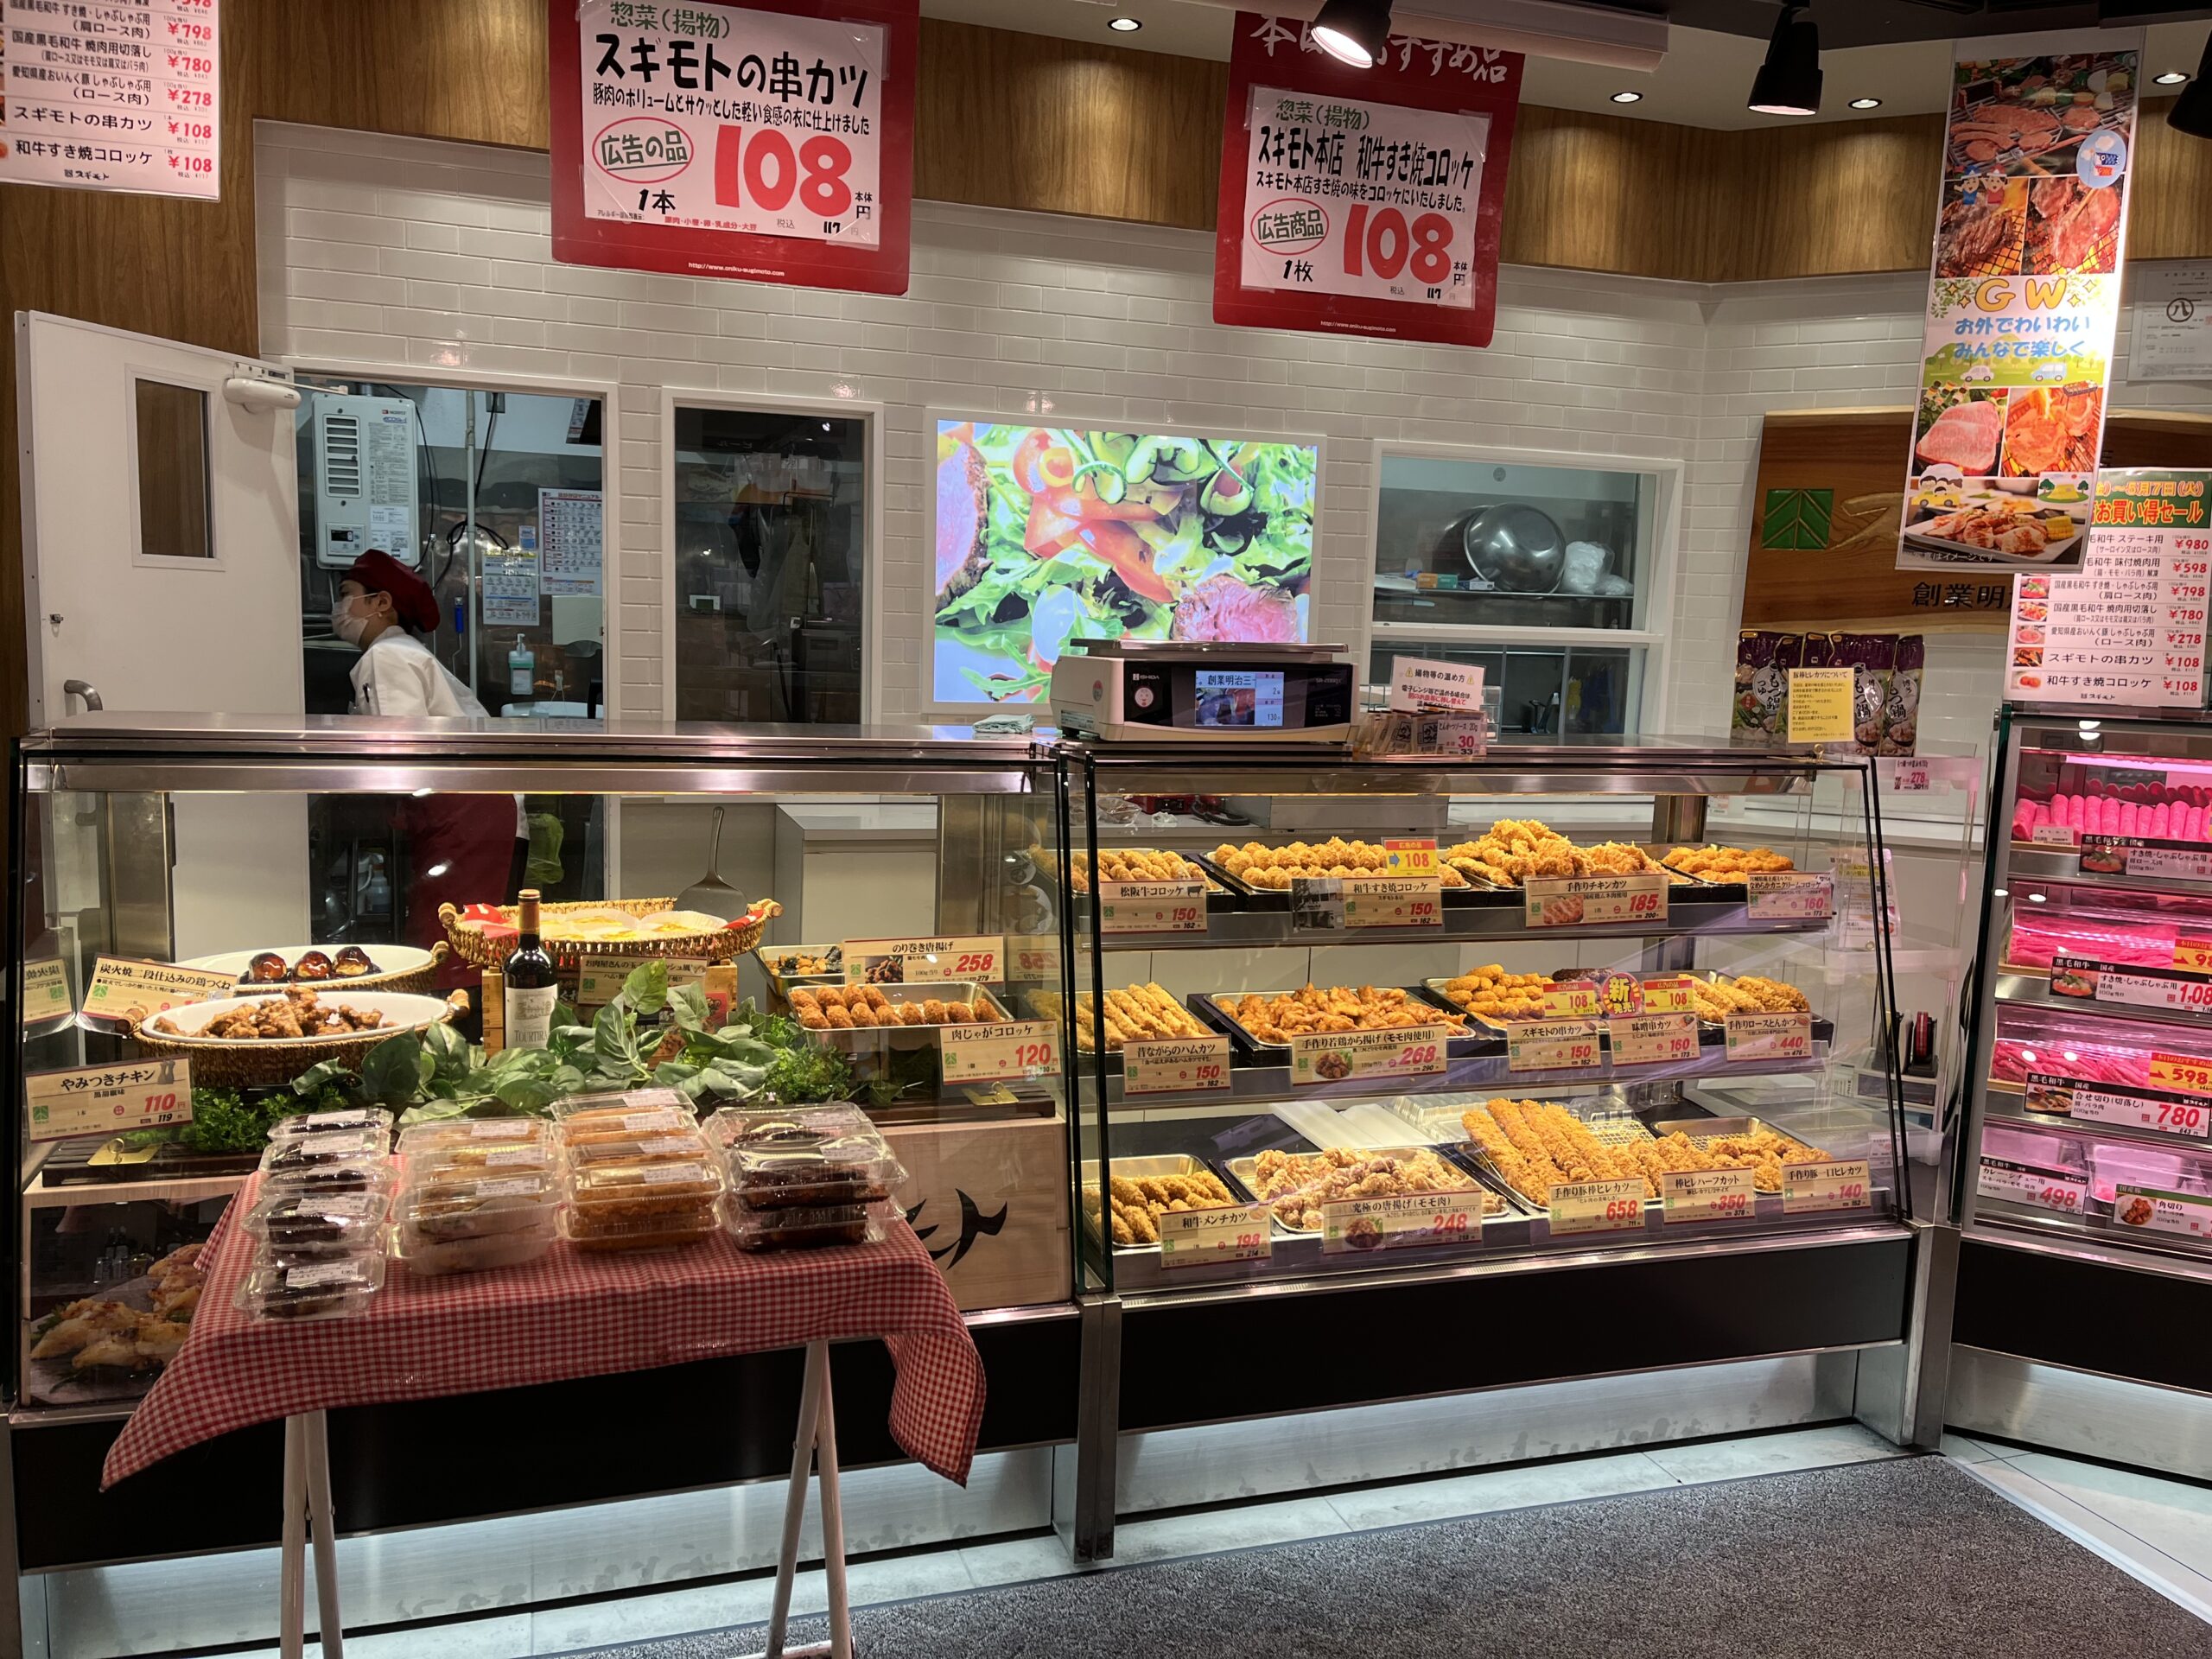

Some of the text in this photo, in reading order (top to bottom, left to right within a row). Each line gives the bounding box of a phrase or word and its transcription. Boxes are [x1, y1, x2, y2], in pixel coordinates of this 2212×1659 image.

[12, 30, 152, 58] 国産黒毛和牛 焼肉用切落し
[595, 33, 868, 108] スギモトの串カツ
[92, 74, 151, 92] しゃぶしゃぶ用
[593, 82, 869, 135] 豚肉のボリュームとサクッとした軽い食感の衣に仕上げました
[14, 105, 152, 131] スギモトの串カツ
[16, 139, 153, 165] 和牛すき焼コロッケ
[601, 130, 688, 165] 広告の品
[1357, 133, 1474, 190] 和牛すき焼コロッケ
[715, 124, 851, 217] 108
[639, 189, 676, 214] 1本
[855, 191, 873, 203] 本体
[856, 206, 871, 220] 円
[777, 219, 795, 230] 税込
[823, 221, 841, 234] 117
[1257, 209, 1324, 240] 広告商品
[1344, 204, 1453, 284] 108
[1283, 260, 1313, 283] 1枚
[1390, 285, 1404, 296] 税込
[1427, 287, 1441, 299] 117
[1954, 316, 2090, 335] お外でわいわい
[1953, 340, 2085, 359] みんなで楽しく
[2091, 499, 2204, 524] お買い得セール
[2118, 535, 2164, 543] ステーキ用
[1912, 582, 2012, 609] 創業明
[2049, 653, 2153, 664] スギモトの串カツ
[2047, 675, 2152, 688] 和牛すき焼コロッケ
[1459, 735, 1475, 748] 30
[1405, 853, 1430, 868] 108
[1353, 882, 1428, 893] 和牛すき焼コロッケ
[1567, 880, 1627, 892] 手作りチキンカツ
[1410, 902, 1433, 916] 150
[1629, 893, 1659, 912] 185
[1804, 898, 1824, 909] 160
[1172, 907, 1197, 921] 150
[893, 941, 954, 953] のり巻き唐揚げ
[955, 953, 994, 973] 258
[2056, 957, 2090, 969] 黒毛和牛
[99, 963, 231, 990] 炭火焼二段仕込みの鶏つくね
[1608, 976, 1630, 1002] 新
[1569, 995, 1588, 1008] 108
[1669, 992, 1688, 1006] 108
[951, 1024, 1033, 1040] 肉じゃがコロッケ
[1522, 1026, 1582, 1038] スギモトの串カツ
[1729, 1019, 1796, 1030] 手作りロースとんかつ
[1669, 1038, 1690, 1052] 160
[1780, 1036, 1803, 1048] 440
[1015, 1043, 1051, 1067] 120
[1138, 1043, 1216, 1058] 昔ながらのハムカツ
[1399, 1045, 1437, 1065] 268
[1570, 1045, 1592, 1058] 150
[1196, 1065, 1220, 1078] 150
[2171, 1067, 2208, 1084] 598
[60, 1070, 156, 1091] やみつきチキン
[2031, 1074, 2065, 1086] 黒毛和牛
[144, 1093, 175, 1113] 110
[158, 1114, 172, 1122] 119
[2156, 1103, 2200, 1128] 780
[1675, 1174, 1739, 1189] 棒ヒレハーフカット
[1555, 1182, 1630, 1198] 手作り豚棒ヒレカツ
[1839, 1183, 1862, 1198] 140
[2039, 1186, 2077, 1207] 498
[1718, 1193, 1746, 1210] 350
[2158, 1199, 2183, 1211] 角切り
[1606, 1199, 1637, 1221] 658
[1182, 1212, 1247, 1229] 和牛メンチカツ
[1433, 1212, 1468, 1236] 248
[1236, 1233, 1261, 1249] 198
